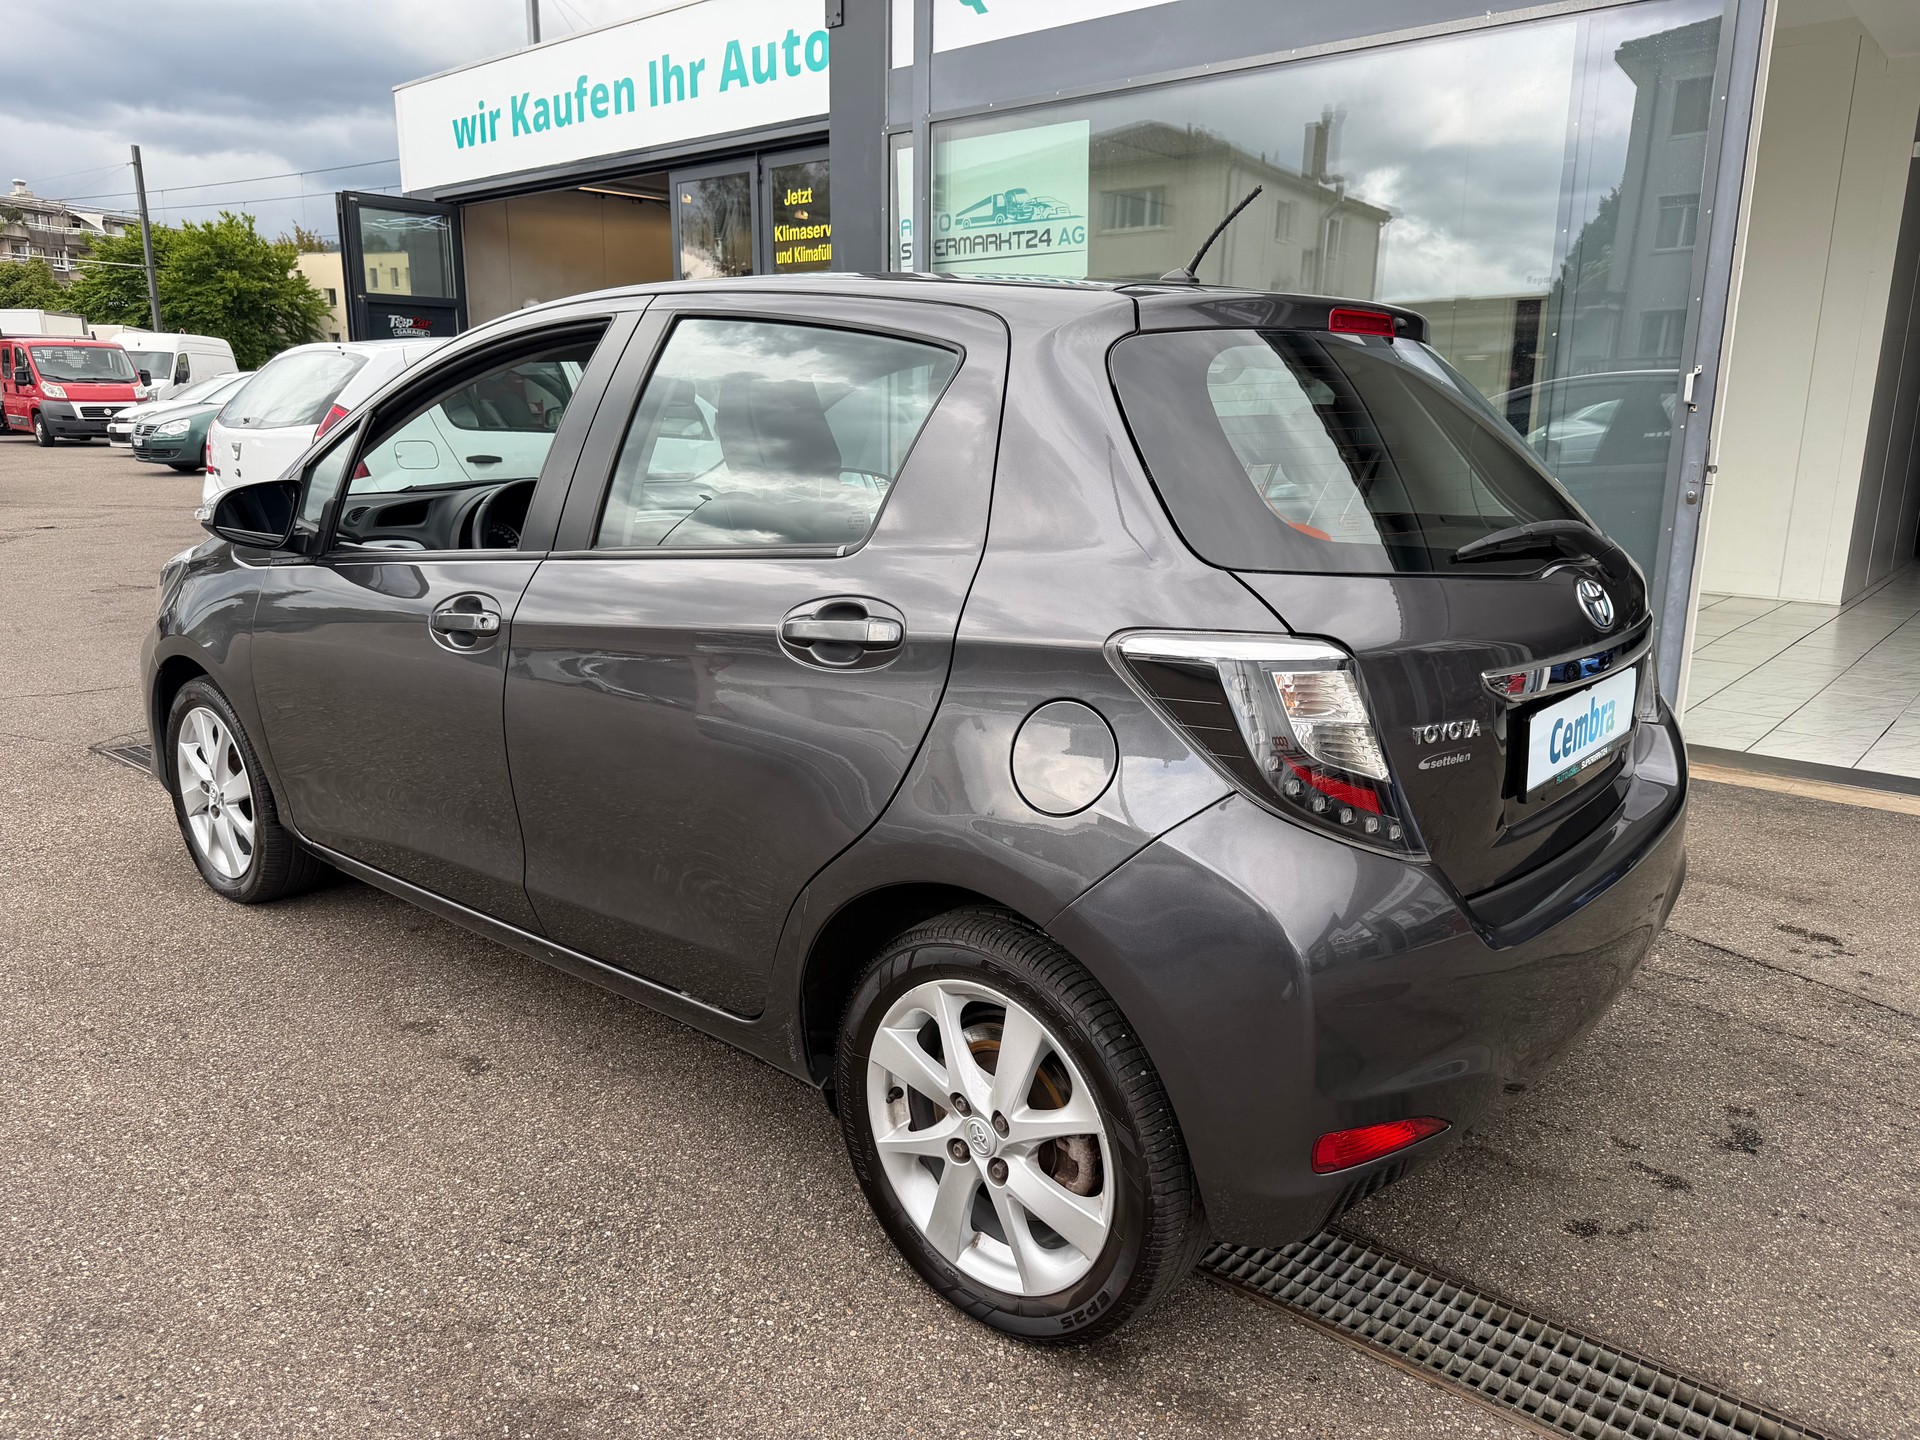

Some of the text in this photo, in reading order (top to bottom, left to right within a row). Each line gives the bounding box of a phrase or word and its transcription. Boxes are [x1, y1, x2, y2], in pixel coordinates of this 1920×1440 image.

[452, 29, 830, 149] wir Kaufen Ihr Auto
[784, 187, 813, 206] Jetzt
[774, 224, 832, 242] Klimaserv
[901, 225, 1085, 260] SERMARKT24 AG
[776, 243, 832, 265] und Klimafüll
[1411, 719, 1482, 746] TOYOTA
[1549, 696, 1616, 765] Cembra
[1430, 751, 1471, 769] settelen
[980, 958, 1084, 1049] ECOPIA
[1058, 1289, 1111, 1331] EP25
